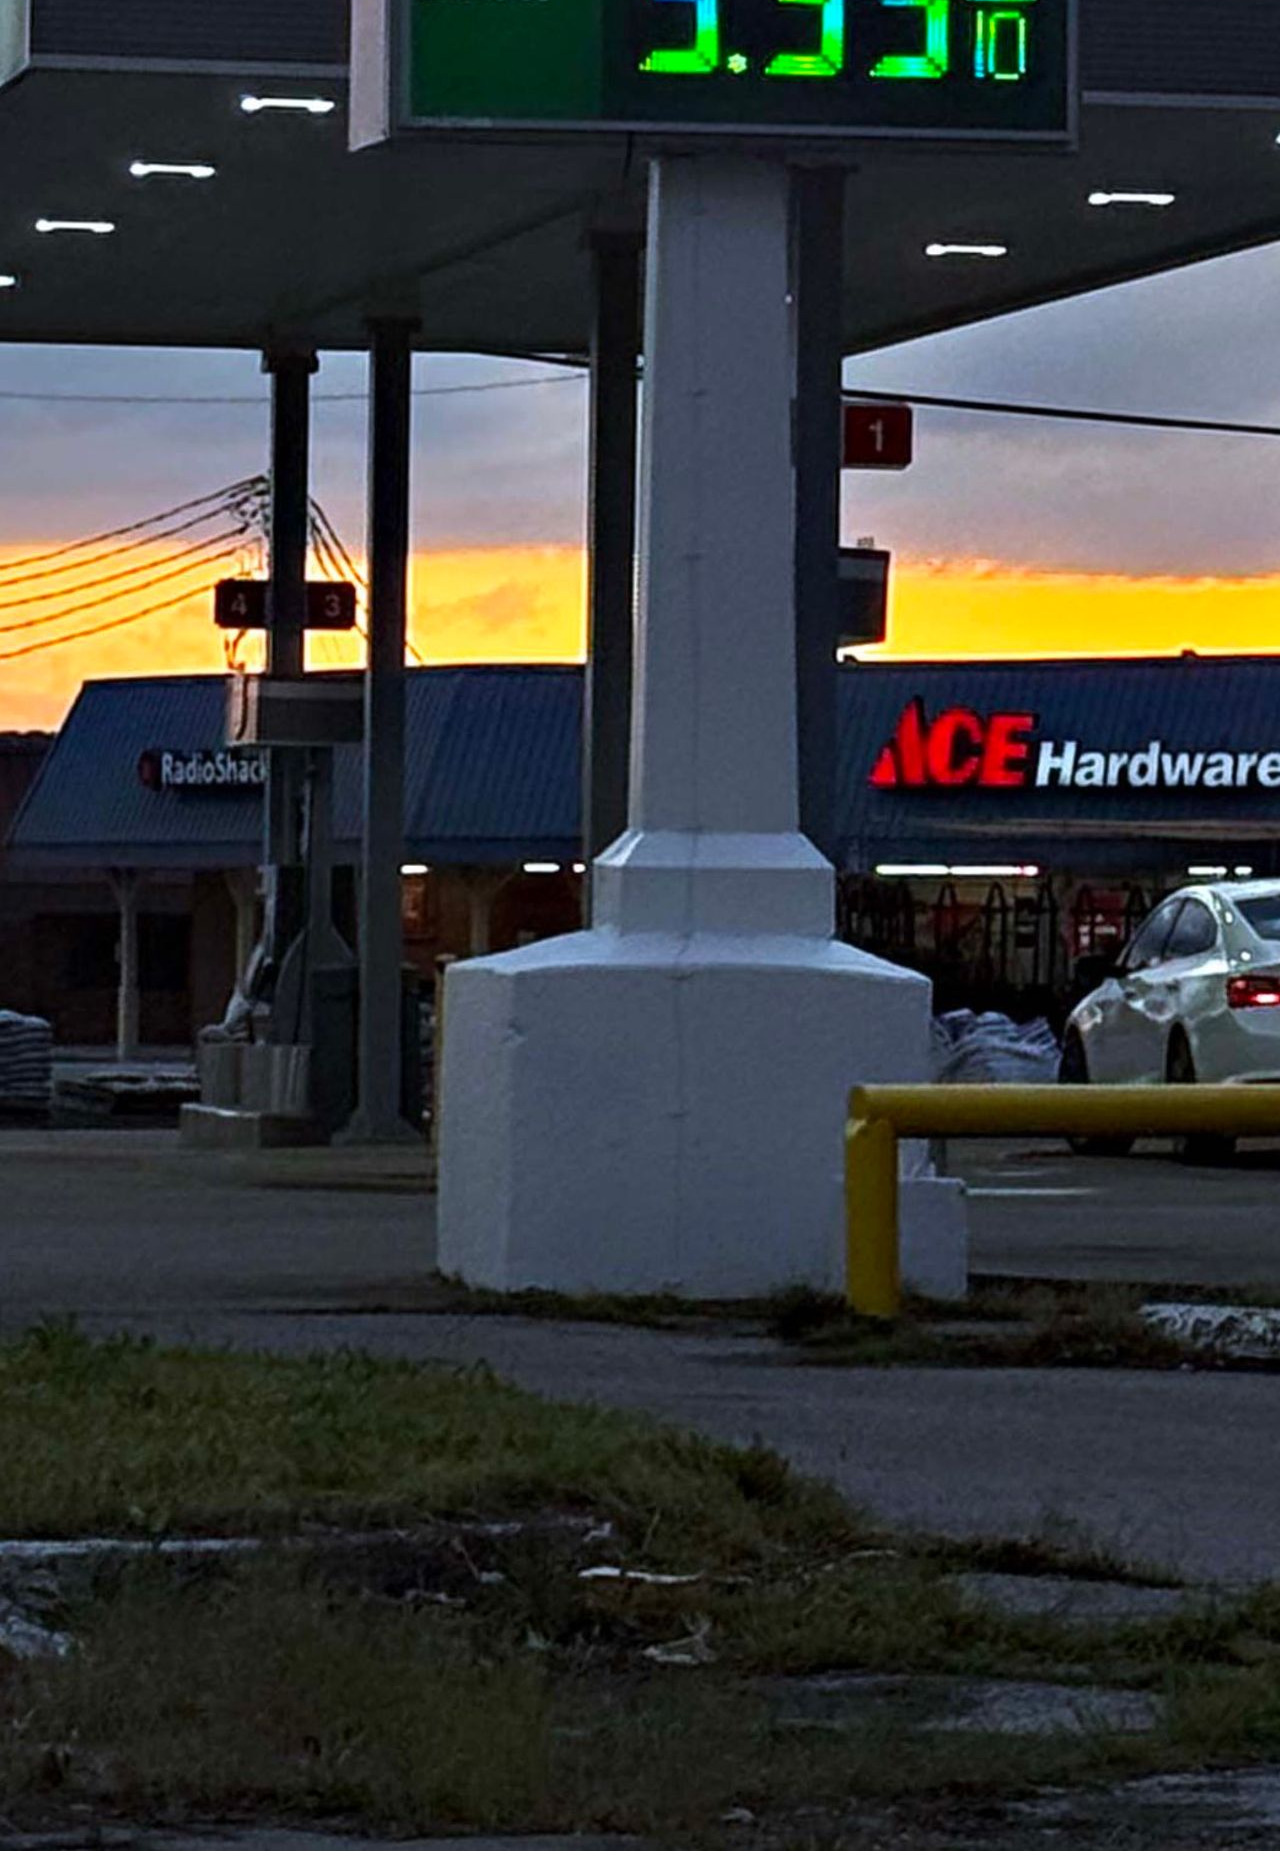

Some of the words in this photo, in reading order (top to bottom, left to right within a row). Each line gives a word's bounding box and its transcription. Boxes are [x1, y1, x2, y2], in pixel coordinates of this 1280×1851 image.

[868, 418, 884, 452] 1
[230, 592, 248, 615] 4
[324, 594, 341, 617] 3
[868, 696, 1037, 788] ACE
